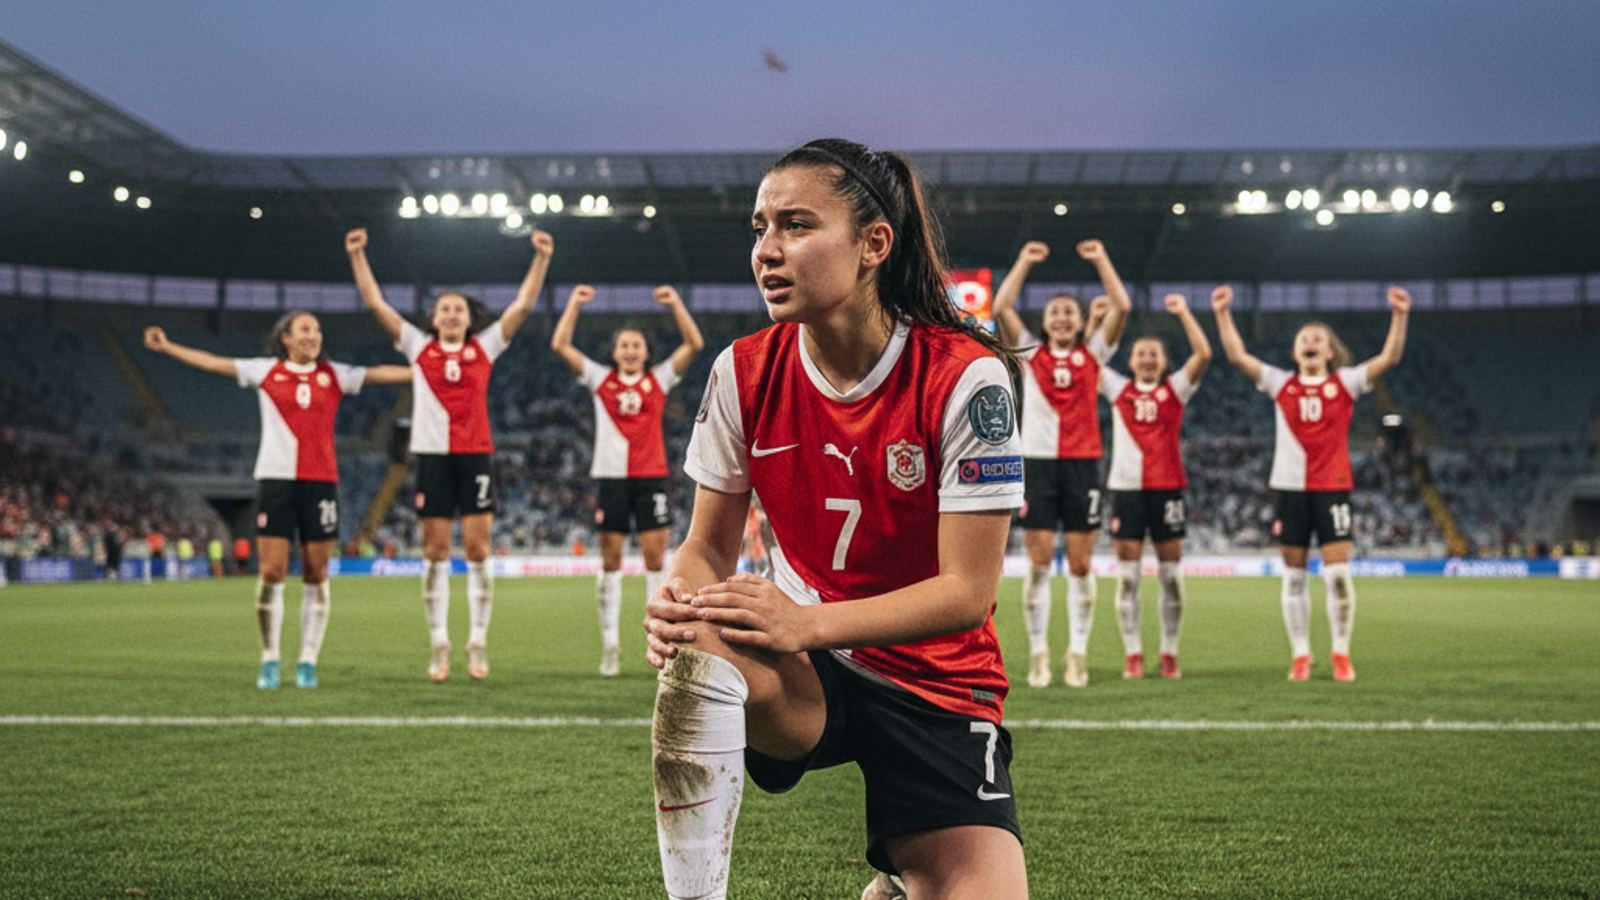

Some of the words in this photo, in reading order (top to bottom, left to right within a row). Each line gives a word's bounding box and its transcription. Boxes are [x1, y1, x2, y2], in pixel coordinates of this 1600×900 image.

[1299, 396, 1322, 422] 10
[476, 475, 490, 499] 7
[1088, 489, 1100, 515] 7
[825, 498, 862, 571] 7
[970, 721, 998, 784] 7
